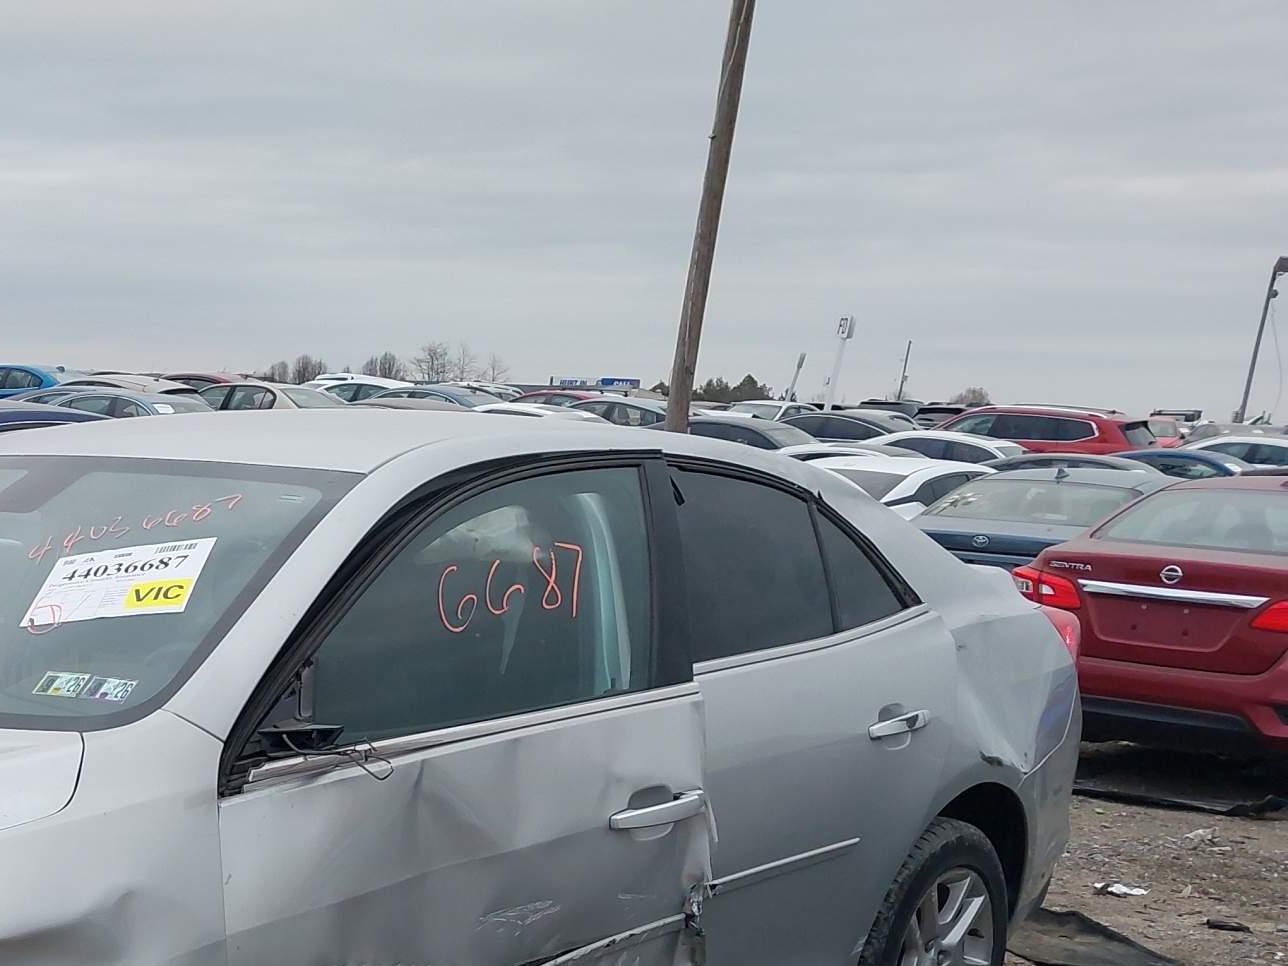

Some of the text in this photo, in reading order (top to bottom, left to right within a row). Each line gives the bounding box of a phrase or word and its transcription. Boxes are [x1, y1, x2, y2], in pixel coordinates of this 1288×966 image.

[62, 554, 190, 582] 44036687
[1049, 560, 1092, 572] SENTRA
[133, 584, 185, 602] VIC
[438, 541, 584, 633] 6687
